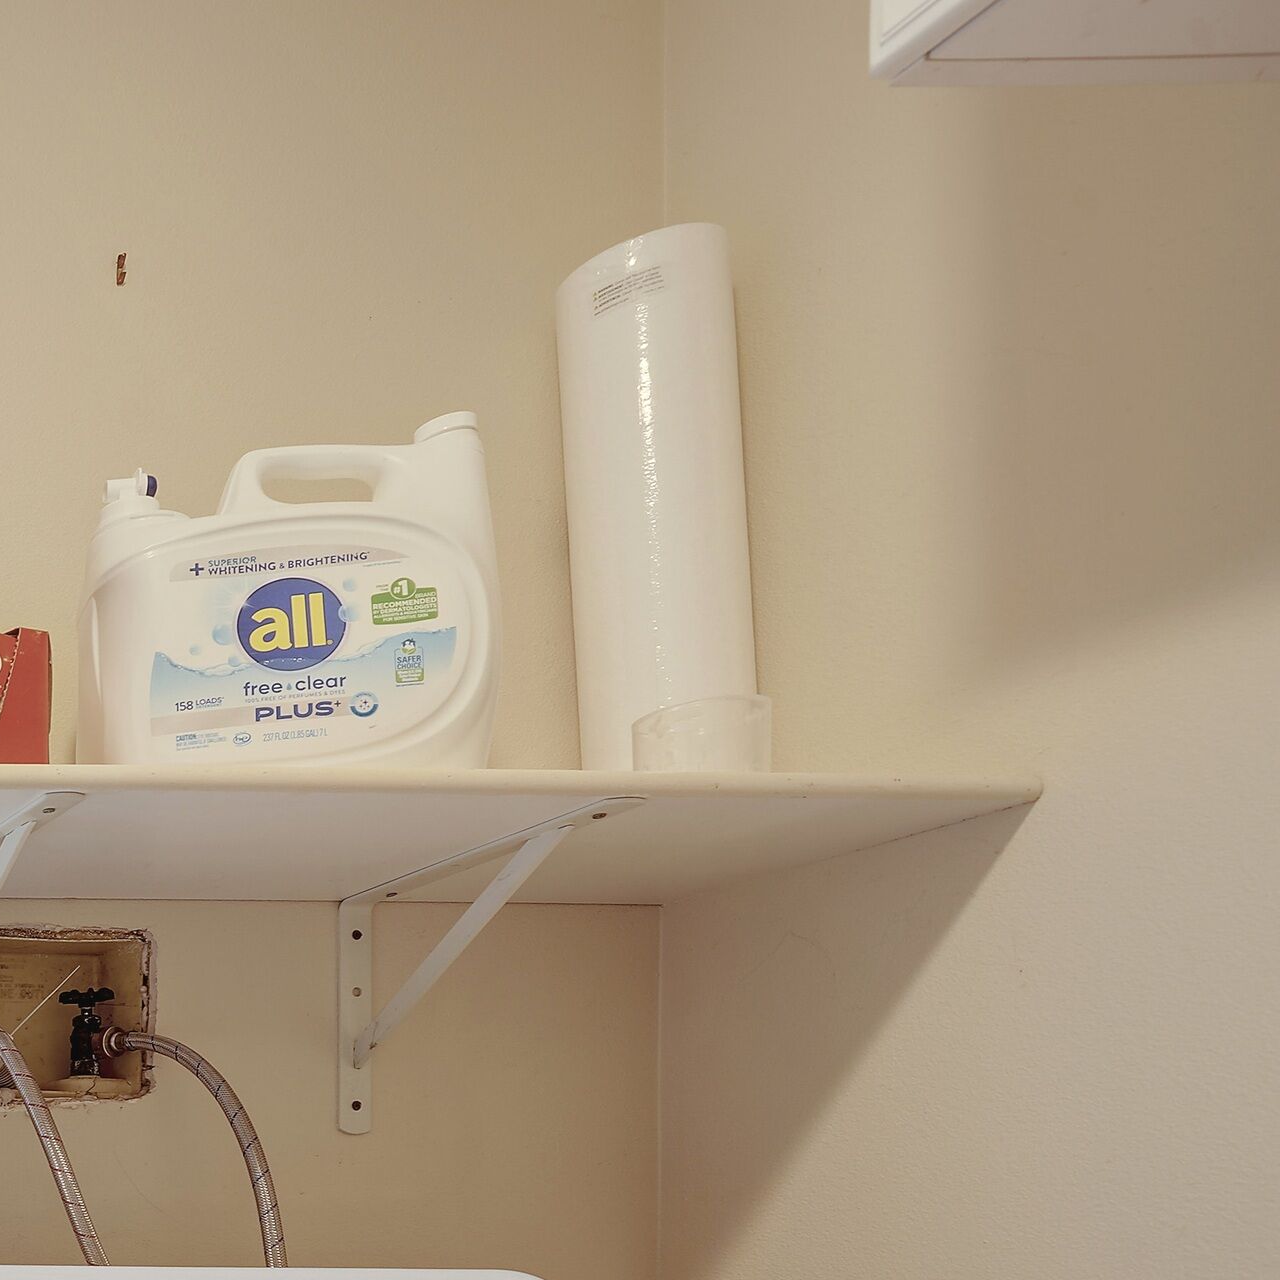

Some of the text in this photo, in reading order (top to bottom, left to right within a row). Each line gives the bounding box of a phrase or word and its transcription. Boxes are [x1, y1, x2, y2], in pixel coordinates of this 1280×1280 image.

[208, 556, 257, 567] SUPERIOR
[208, 562, 276, 575] WHITENING
[288, 552, 368, 568] BRIGHTENING
[393, 580, 409, 595] #1
[373, 597, 437, 610] RECOMMENDED
[248, 592, 330, 653] all
[397, 655, 421, 664] SAFER
[397, 662, 421, 670] CHOICE
[243, 675, 346, 697] free clear
[175, 701, 194, 712] 158
[263, 733, 274, 742] 237
